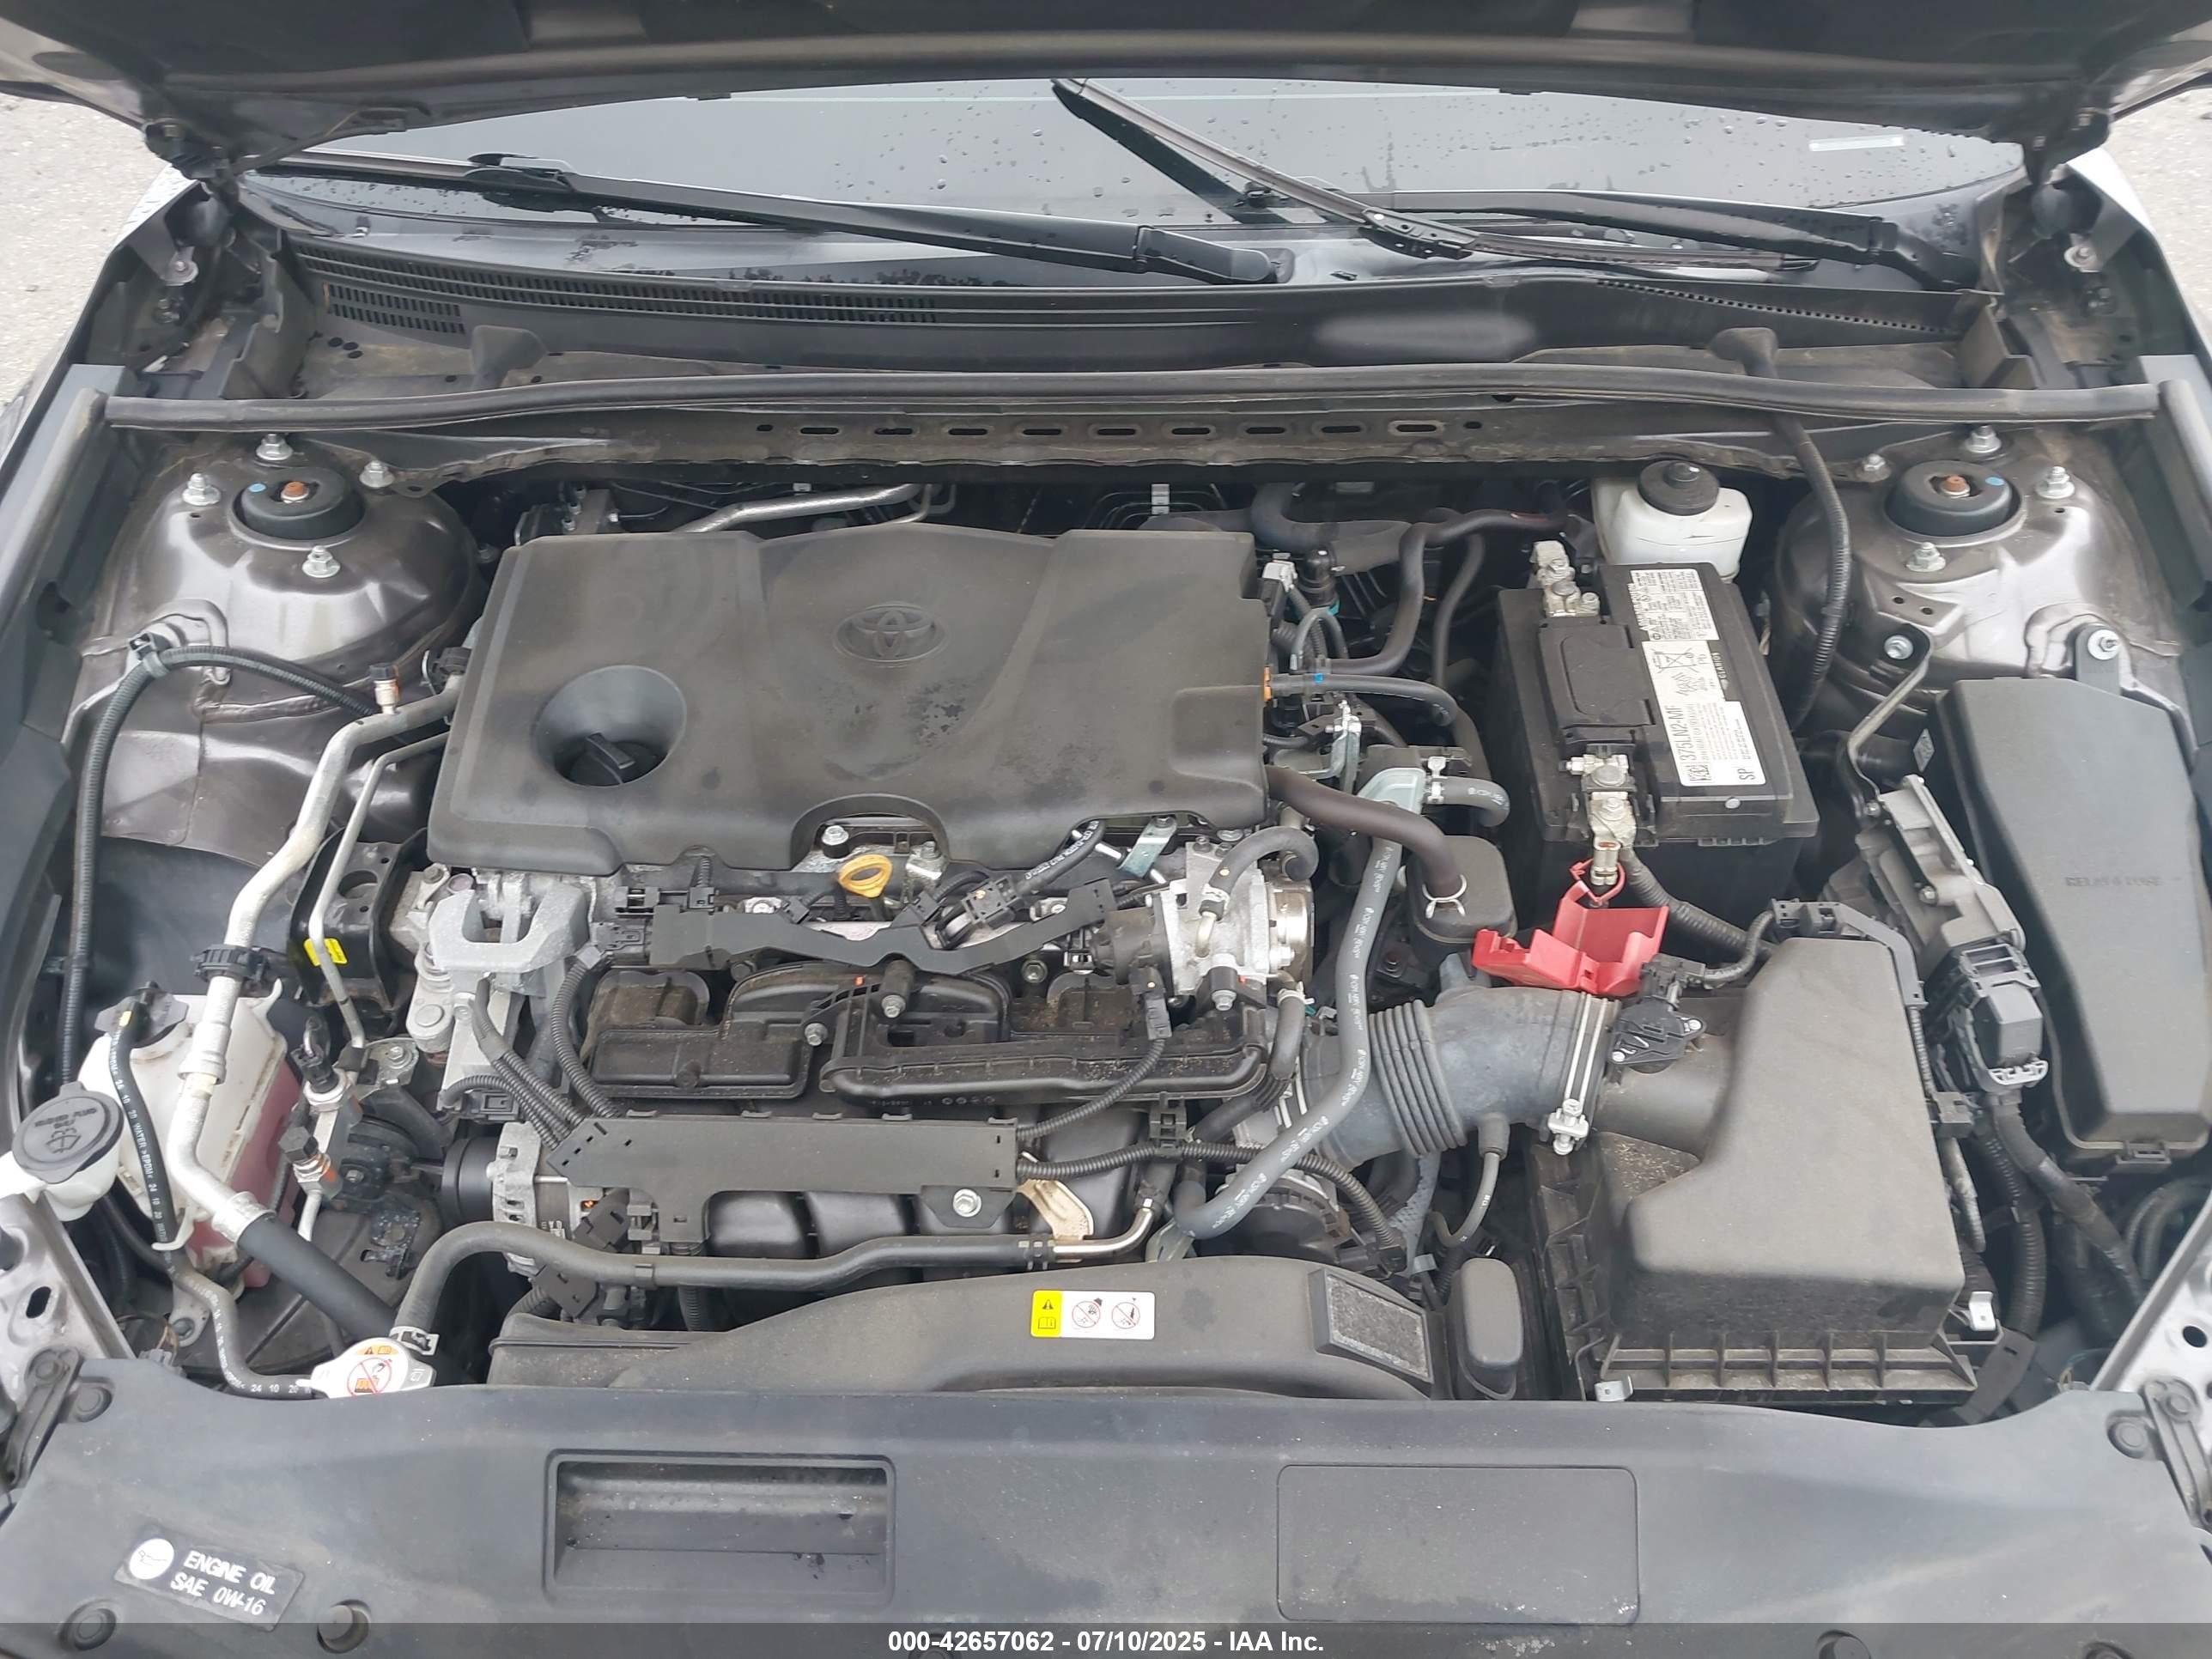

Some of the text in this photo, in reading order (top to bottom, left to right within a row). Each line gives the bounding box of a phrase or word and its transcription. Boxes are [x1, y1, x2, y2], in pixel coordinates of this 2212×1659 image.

[1736, 768, 1756, 781] SP
[269, 1383, 280, 1393] 10
[183, 1550, 276, 1595] ENGINE OIL
[170, 1571, 209, 1597] SAE
